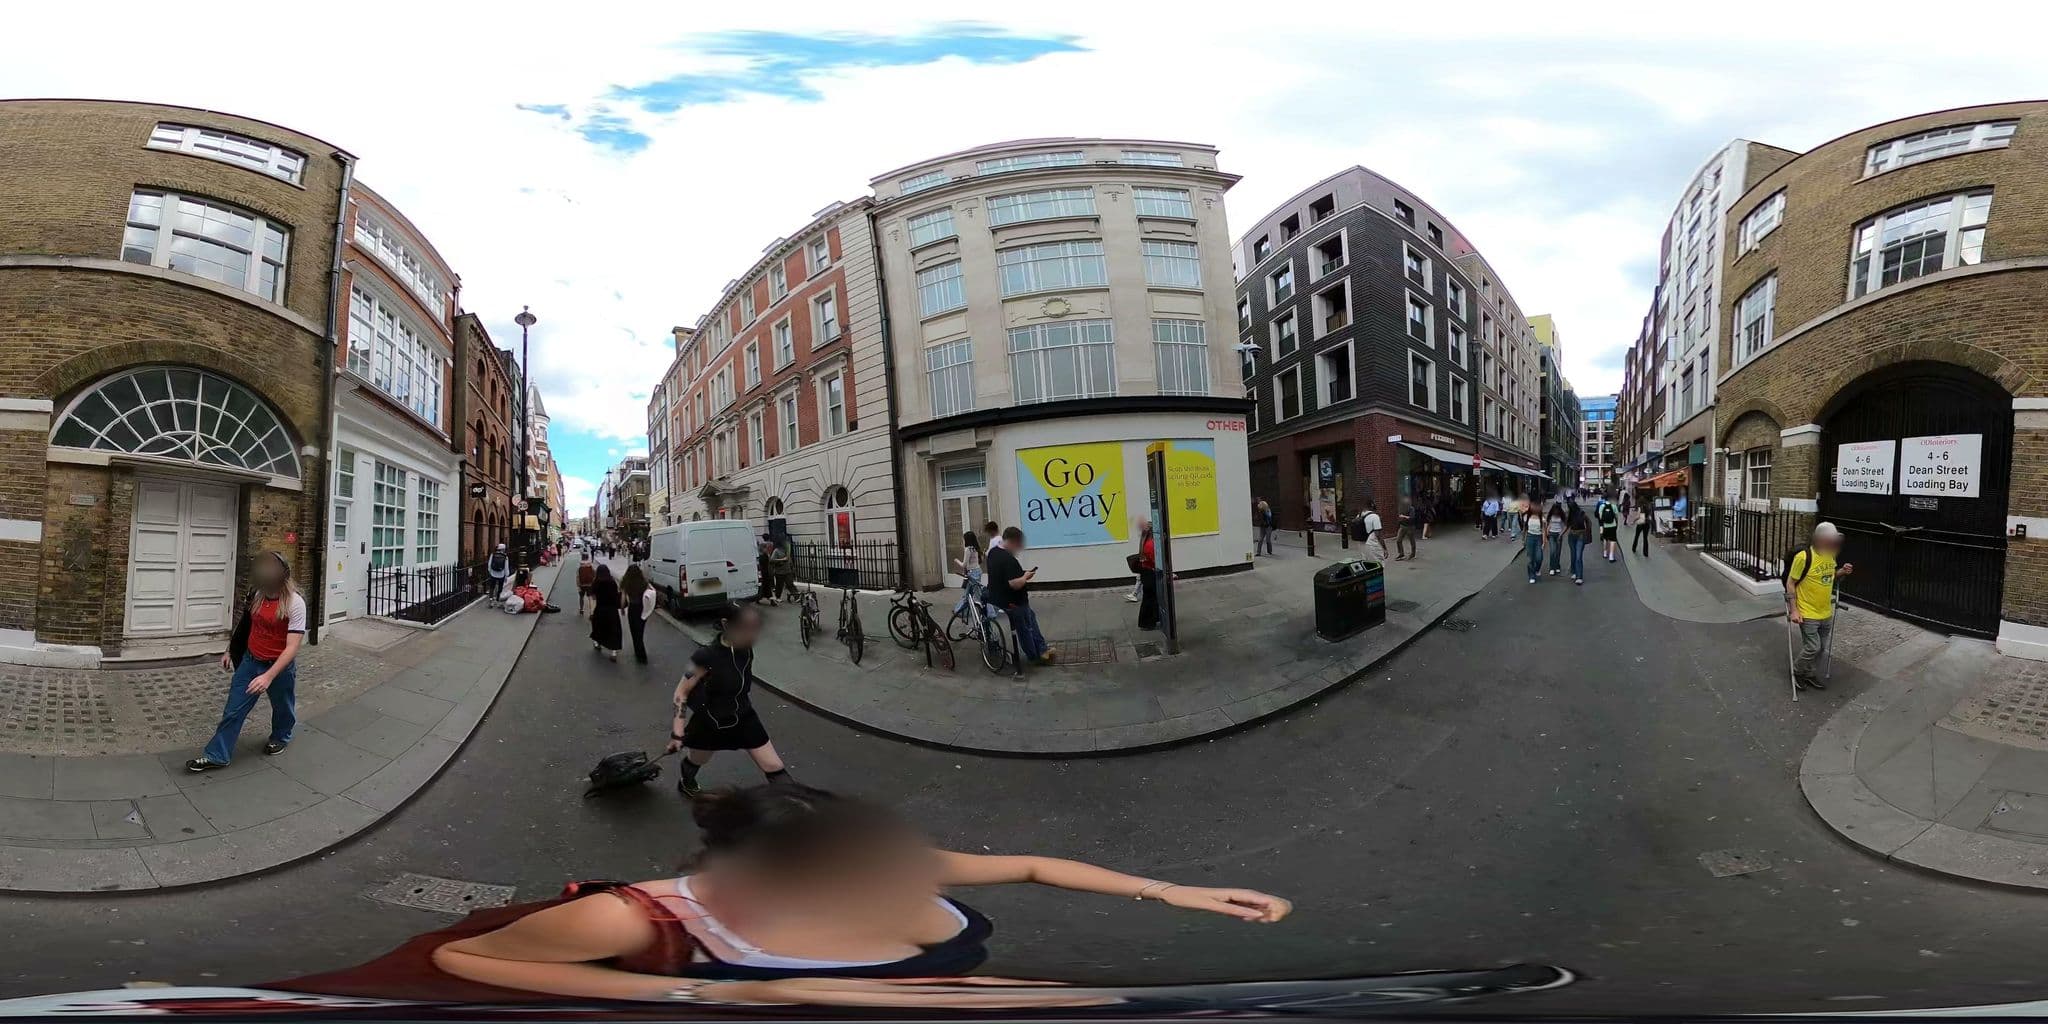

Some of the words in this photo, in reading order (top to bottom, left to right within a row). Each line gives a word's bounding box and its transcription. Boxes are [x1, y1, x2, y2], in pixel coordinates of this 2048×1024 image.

[1207, 420, 1246, 431] OTHER
[1855, 455, 1860, 463] 4
[1865, 455, 1871, 463] 6
[1927, 451, 1933, 460] 4
[1943, 451, 1949, 461] 6
[1043, 457, 1094, 488] Go
[1842, 467, 1860, 475] Dean
[1861, 466, 1884, 476] Street
[1909, 465, 1933, 475] Dean
[1936, 464, 1968, 475] Street
[1841, 478, 1868, 490] Loading
[1870, 479, 1884, 490] Bay
[1906, 479, 1946, 492] Loading
[1949, 479, 1969, 493] Bay
[1027, 492, 1117, 525] away
